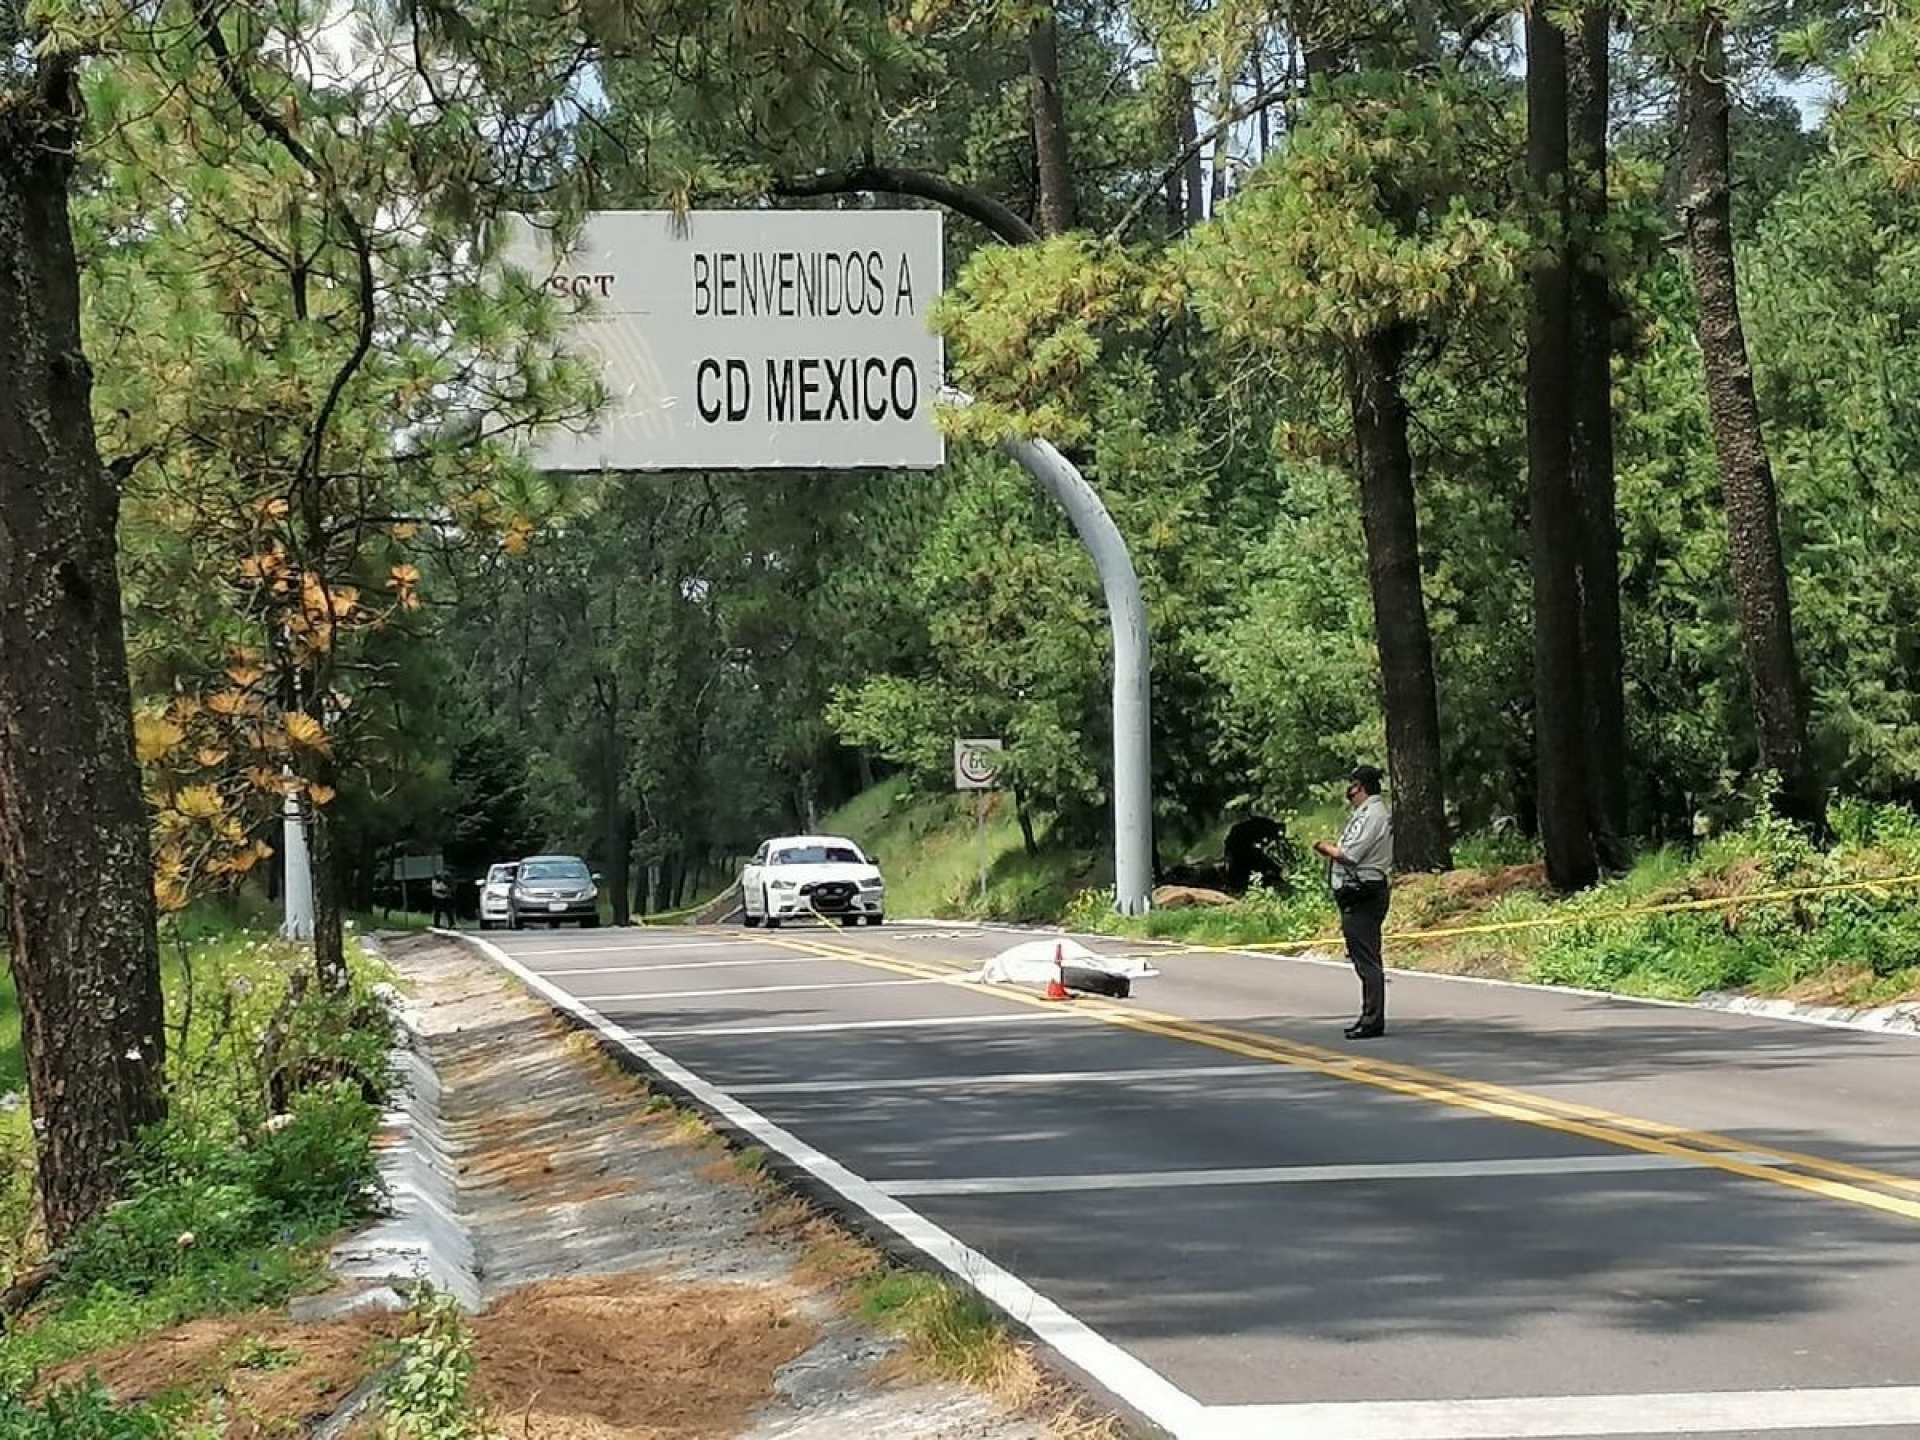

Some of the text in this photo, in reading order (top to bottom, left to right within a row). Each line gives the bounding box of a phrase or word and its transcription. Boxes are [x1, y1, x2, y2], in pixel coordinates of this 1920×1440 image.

[552, 275, 615, 298] SCT
[694, 250, 914, 317] BIENVENIDOS A
[697, 356, 918, 424] CD MEXICO
